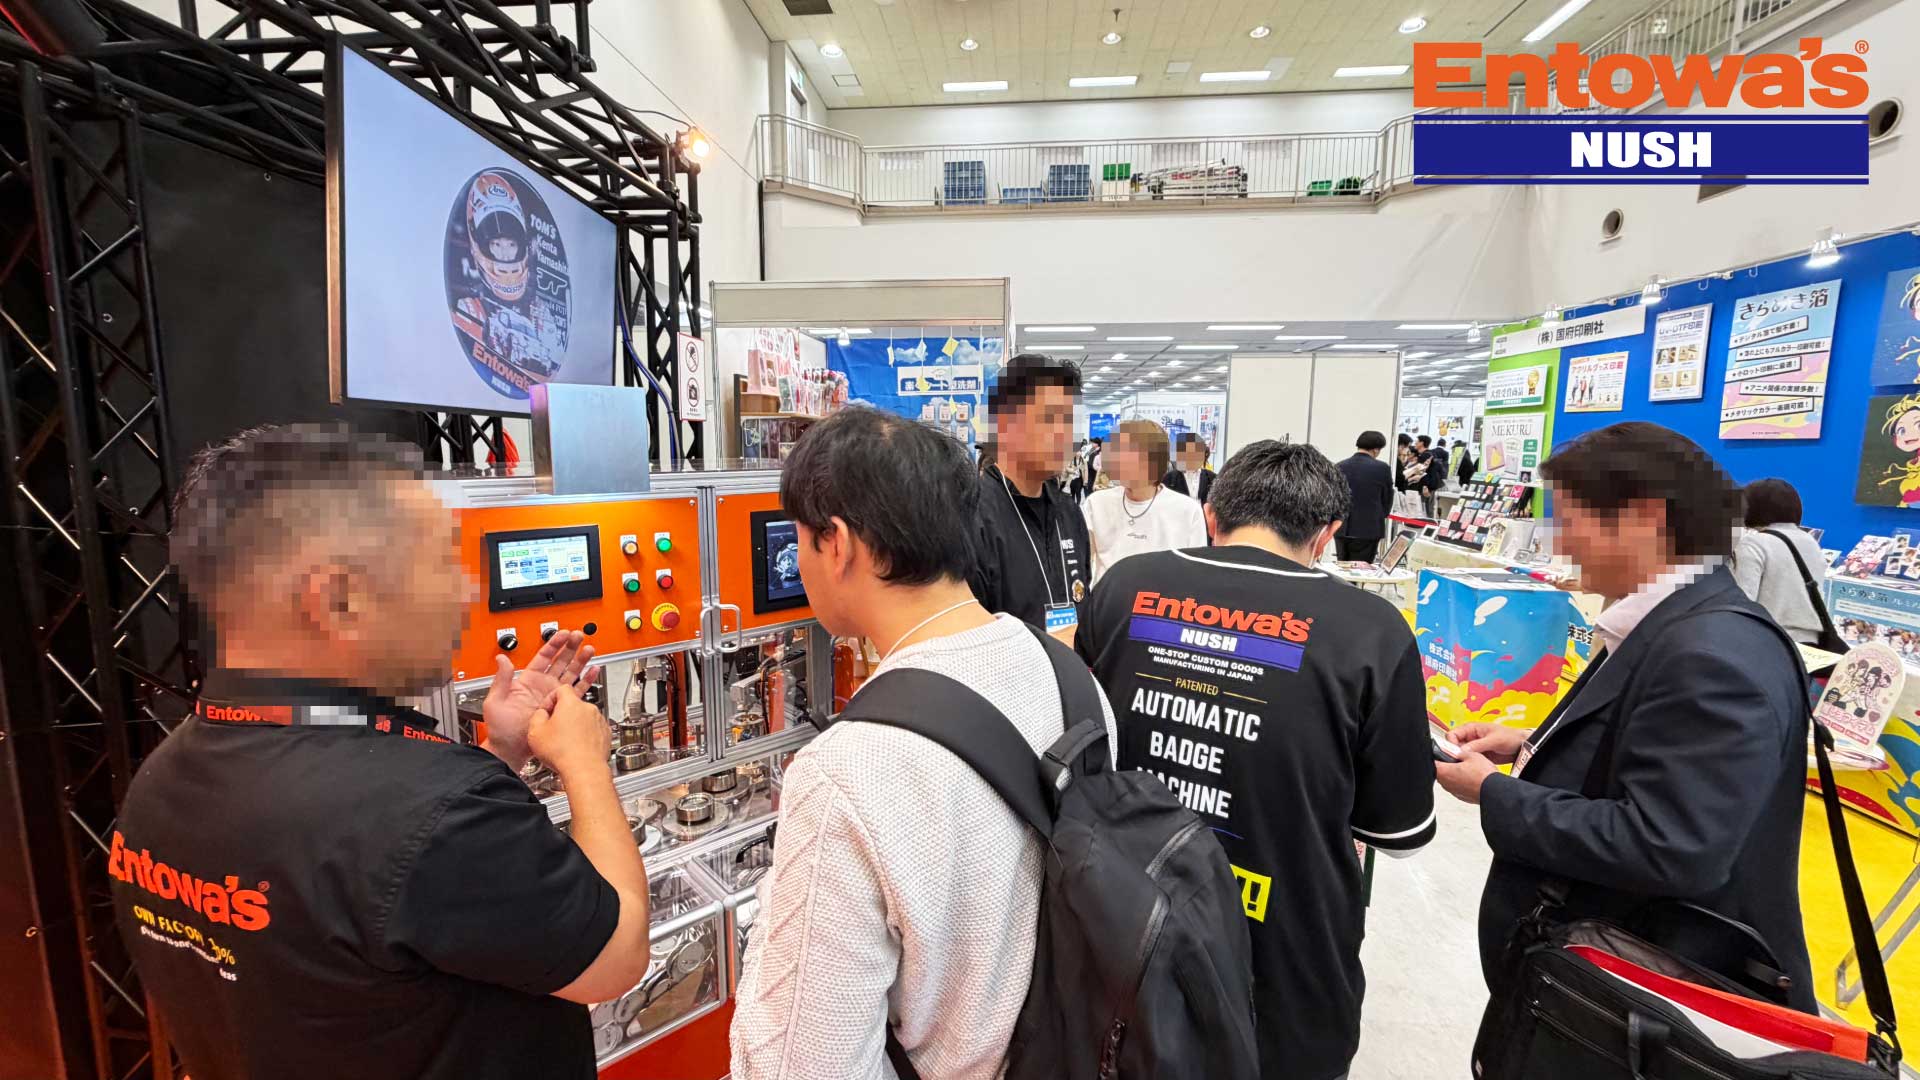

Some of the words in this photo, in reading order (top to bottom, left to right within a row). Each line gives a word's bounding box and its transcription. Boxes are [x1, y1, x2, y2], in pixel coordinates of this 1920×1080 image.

[1740, 287, 1830, 321] きらめき箔
[1491, 423, 1532, 437] MEKURU
[1180, 628, 1238, 652] NUSH
[1147, 645, 1190, 661] ONE-STOP
[1191, 653, 1229, 670] CUSTOM
[1230, 662, 1265, 676] GOODS
[1153, 655, 1216, 675] MANUFACTURING
[1216, 669, 1226, 677] IN
[1226, 671, 1254, 683] JAPAN
[1175, 677, 1220, 697] PATENTED
[1131, 687, 1262, 743] AUTOMATIC
[1149, 731, 1225, 775] BADGE
